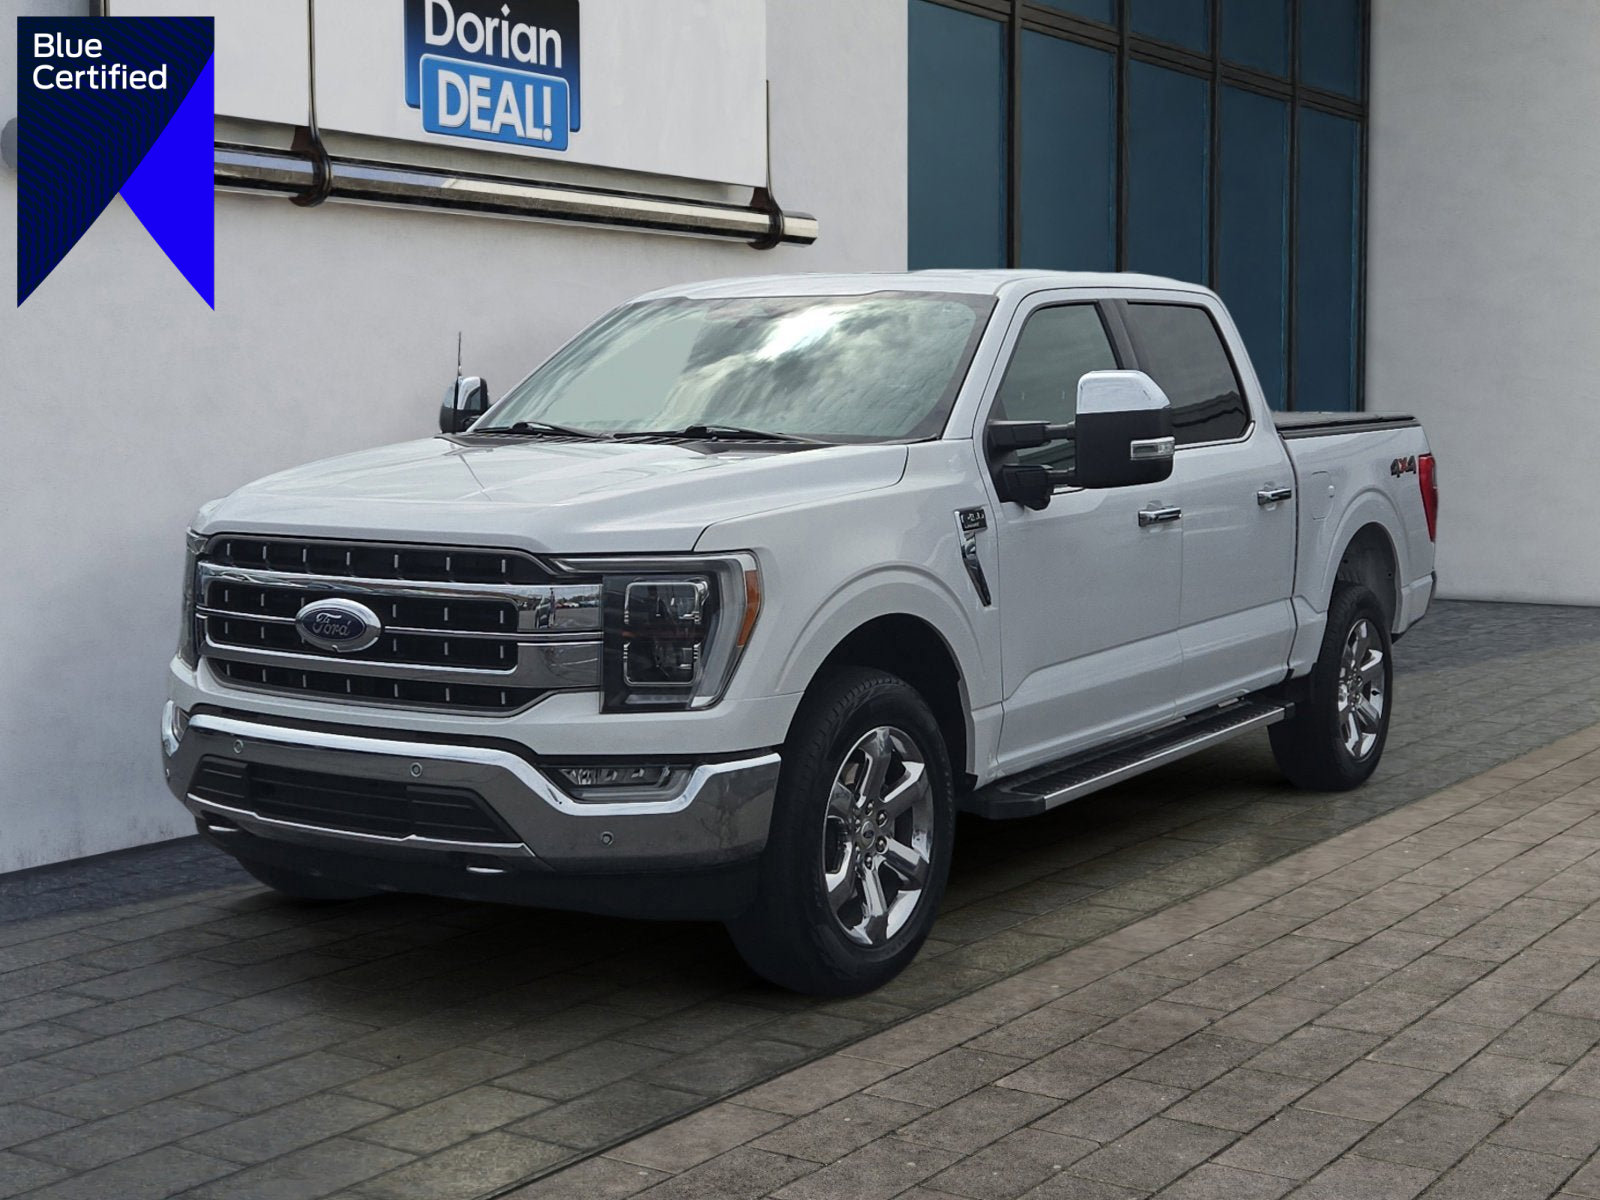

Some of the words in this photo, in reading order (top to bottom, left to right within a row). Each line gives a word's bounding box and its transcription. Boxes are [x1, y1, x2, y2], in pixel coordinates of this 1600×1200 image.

[424, 0, 563, 69] Dorian
[437, 68, 553, 143] DEAL!
[312, 612, 352, 636] Ford
